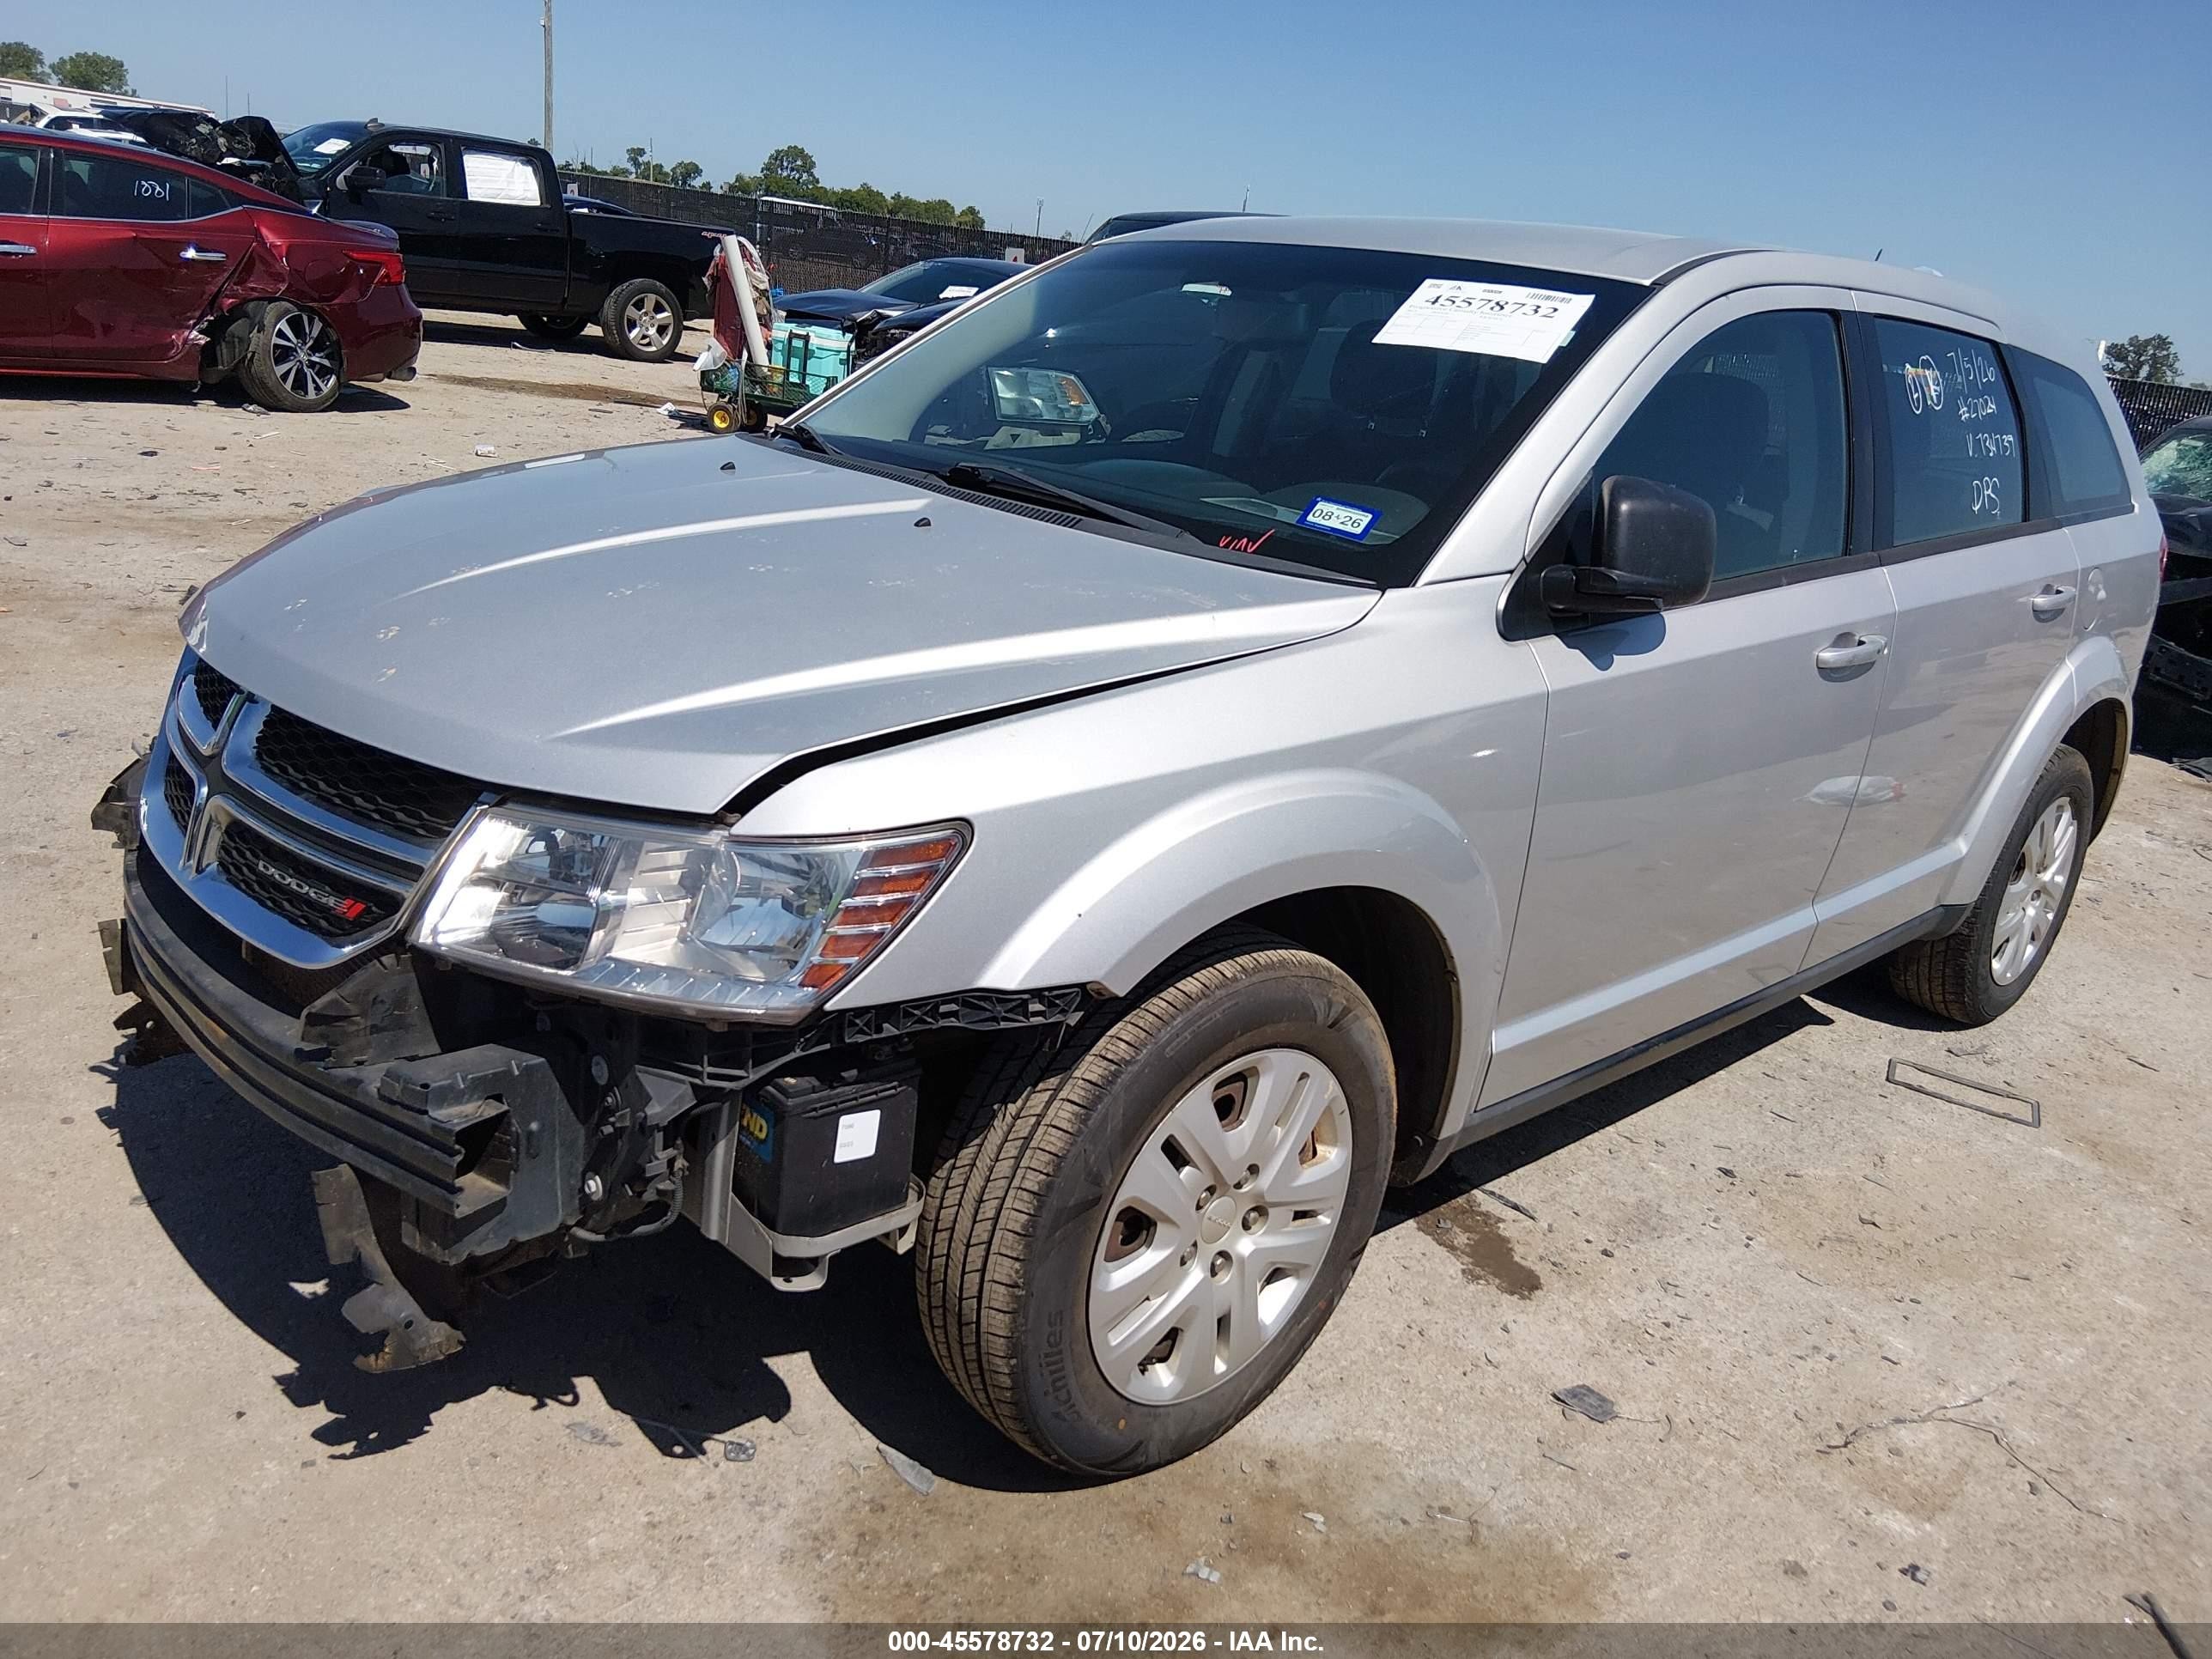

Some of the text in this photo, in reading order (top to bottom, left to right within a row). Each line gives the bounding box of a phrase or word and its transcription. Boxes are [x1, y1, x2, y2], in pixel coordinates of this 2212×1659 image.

[1425, 295, 1559, 319] 45578732
[1946, 348, 1996, 394] 7/5/26
[1311, 508, 1334, 521] 08
[1340, 515, 1364, 529] 26
[258, 860, 348, 912] DODGE
